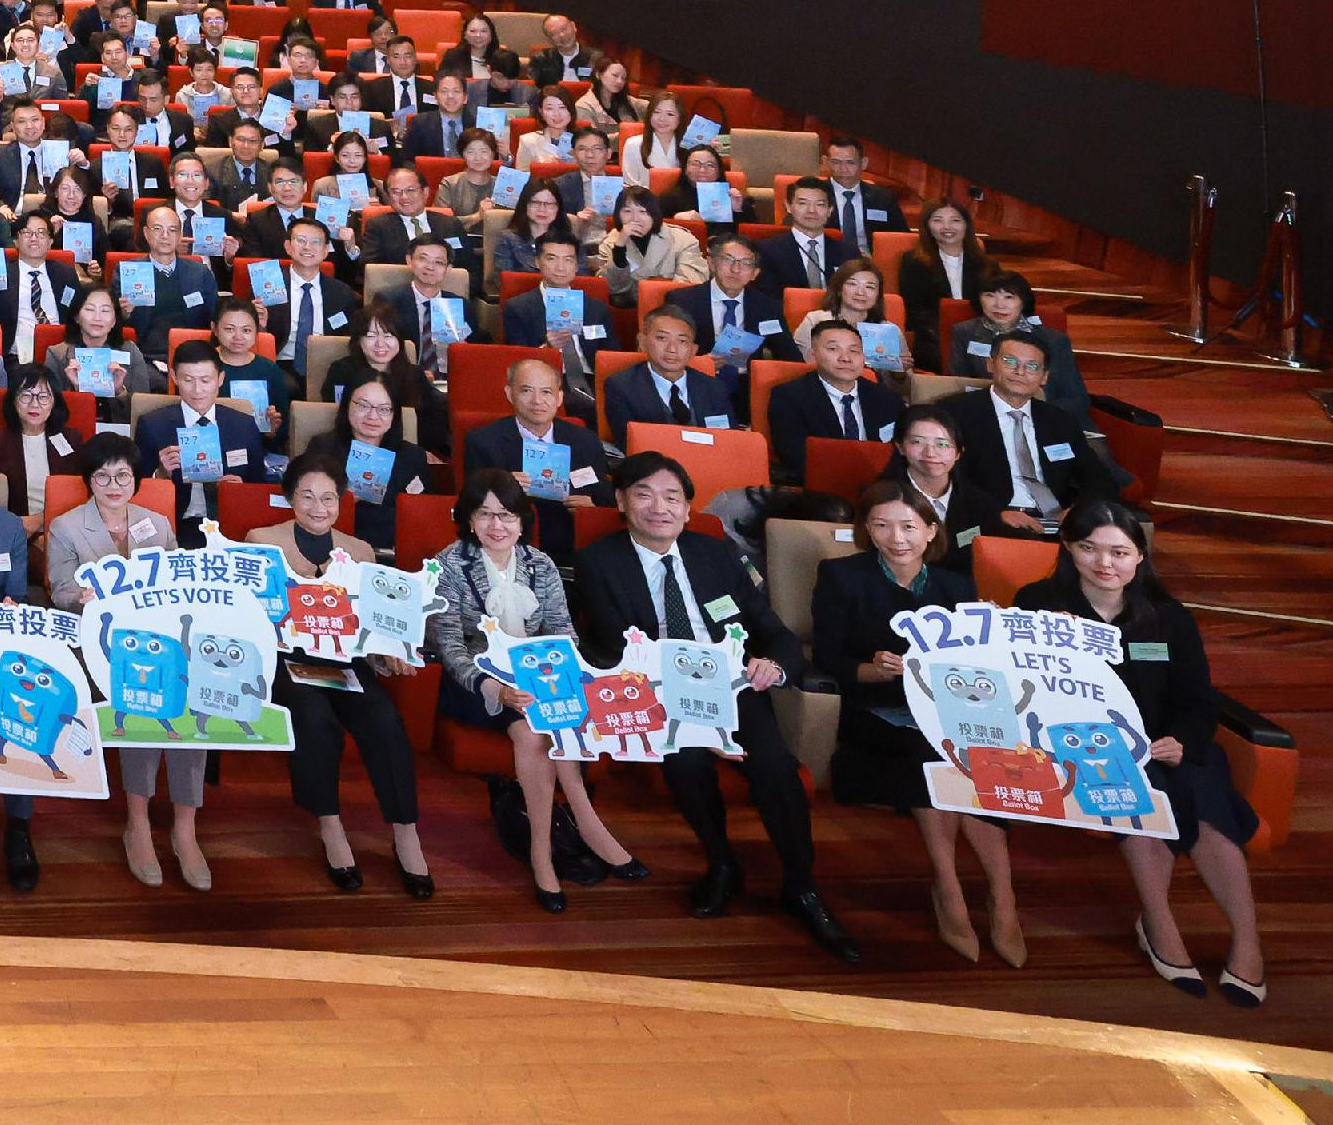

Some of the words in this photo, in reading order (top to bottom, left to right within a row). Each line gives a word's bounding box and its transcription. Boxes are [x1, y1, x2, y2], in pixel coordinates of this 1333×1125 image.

[81, 553, 161, 600] 12.7
[167, 553, 262, 588] 齊投票
[132, 589, 179, 610] LET'S
[183, 588, 234, 605] VOTE
[899, 608, 991, 653] 12.7
[1001, 612, 1118, 659] 齊投票
[1011, 652, 1072, 674] LET'S
[1041, 675, 1105, 703] VOTE
[538, 699, 582, 717] 投票箱
[606, 711, 650, 727] 投票箱
[959, 723, 1004, 741] 投票箱
[994, 785, 1043, 805] 投票箱
[1088, 788, 1137, 804] 投票箱
